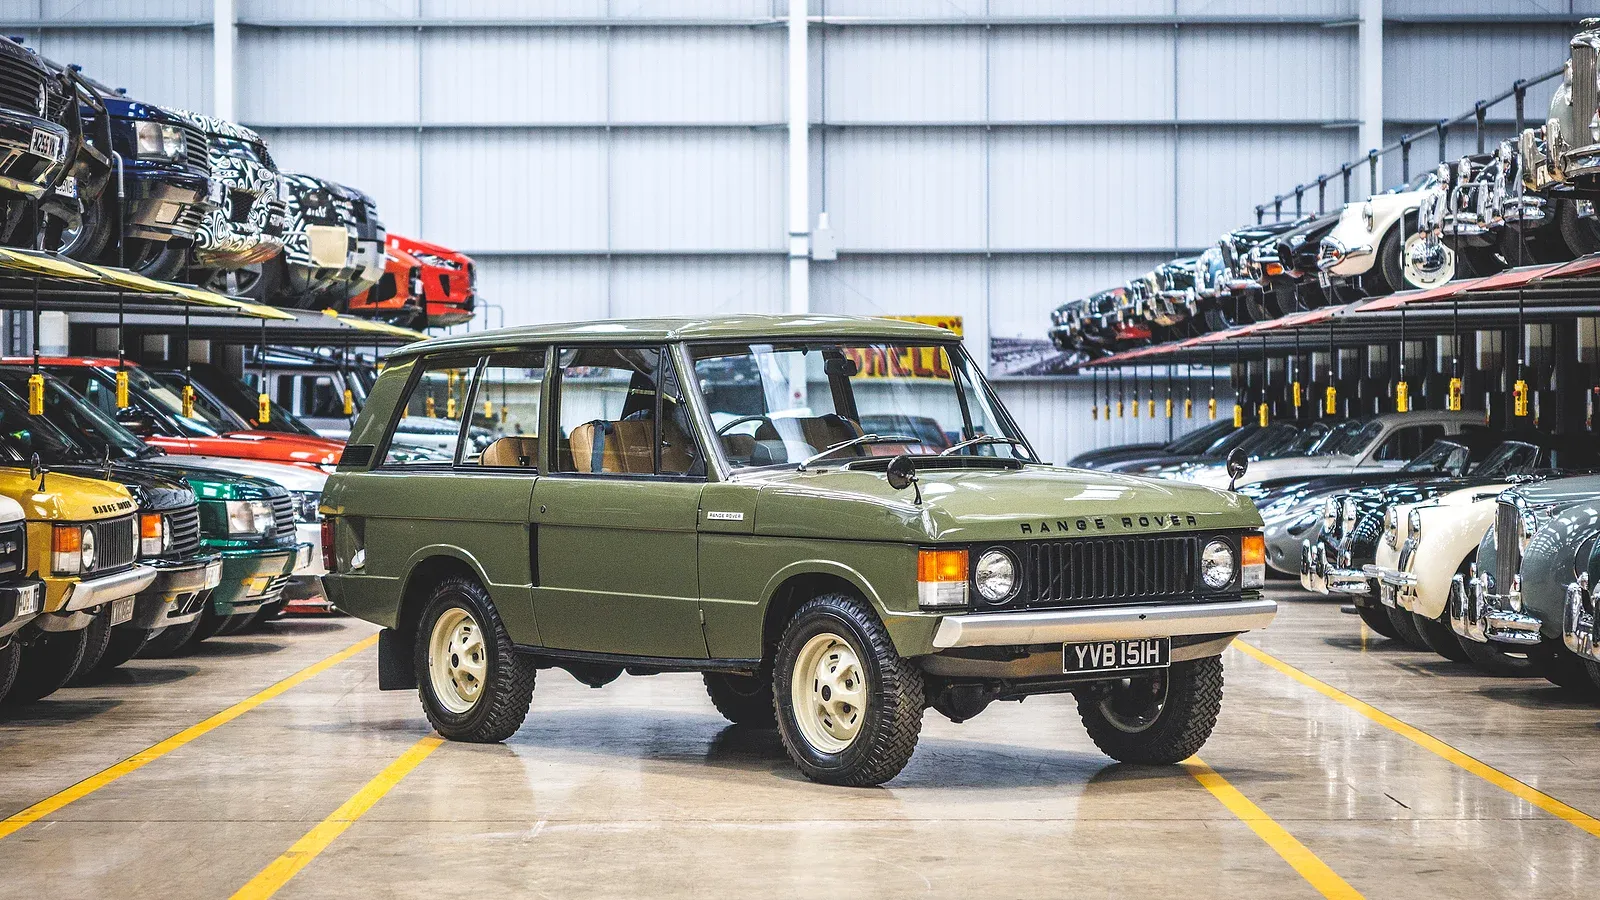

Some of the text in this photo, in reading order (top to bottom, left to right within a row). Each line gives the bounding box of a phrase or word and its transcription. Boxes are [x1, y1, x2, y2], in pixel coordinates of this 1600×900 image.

[1020, 515, 1197, 534] RANGE ROVER
[1075, 640, 1160, 669] YVB 151H
